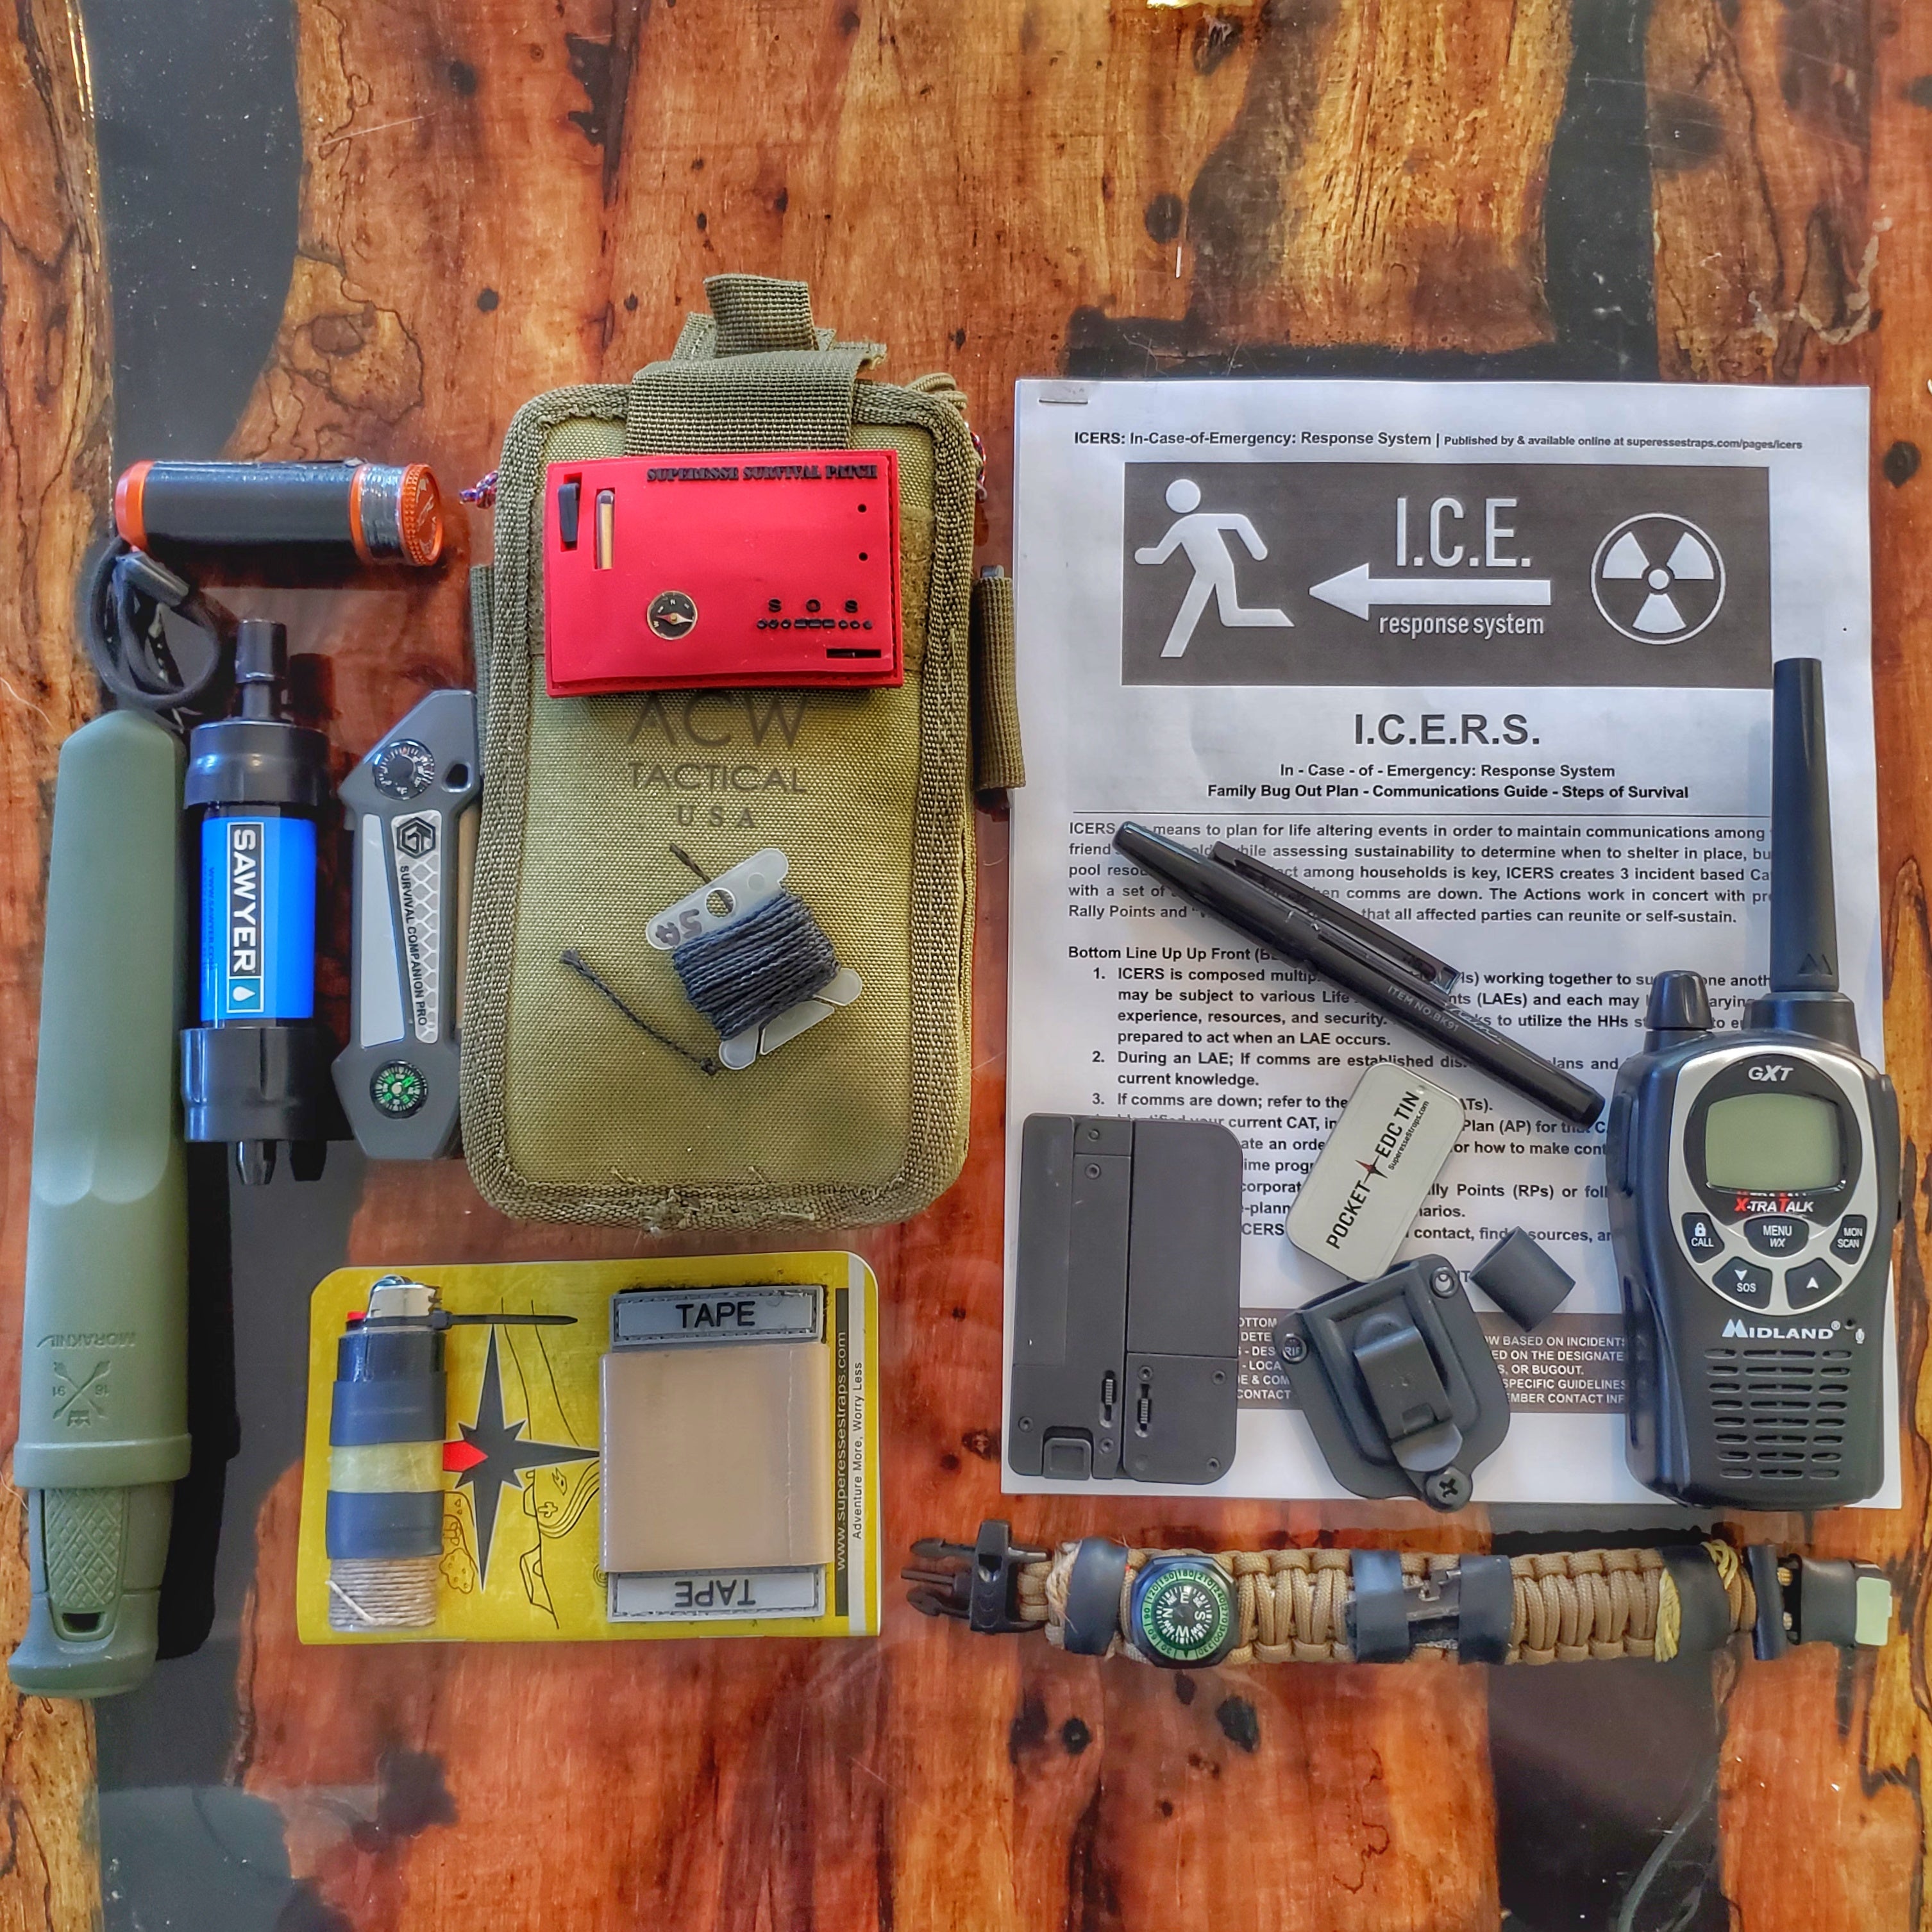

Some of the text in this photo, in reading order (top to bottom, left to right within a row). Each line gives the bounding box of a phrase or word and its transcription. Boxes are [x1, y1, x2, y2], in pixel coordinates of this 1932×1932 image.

[1075, 432, 1802, 451] ICERS: In-Case-of-Emergency: Response System Published by & available online at superessestraps.com/pages/icers
[647, 465, 877, 482] SUPERESSE SURVIVAL PATCH
[1397, 498, 1531, 567] I.C.E.
[1380, 614, 1543, 639] response system
[626, 692, 808, 749] ACW
[1356, 714, 1539, 744] I.C.E.R.S.
[628, 762, 807, 793] TACTICAL
[1281, 764, 1615, 780] In Case of Emergency: Response System
[1208, 784, 1688, 801] Family Bug Out Plan Communications Guide Steps of Survival
[1070, 821, 1115, 835] ICERS
[1207, 825, 1220, 836] to
[1227, 823, 1257, 839] plan
[1263, 823, 1284, 836] for
[1289, 824, 1311, 836] life
[1317, 824, 1372, 839] altering
[1379, 825, 1427, 837] events
[1434, 825, 1447, 837] in
[1453, 825, 1493, 837] order
[1498, 825, 1513, 837] to
[1518, 825, 1581, 837] maintain
[1586, 825, 1709, 838] communications
[1715, 829, 1764, 841] among
[1273, 844, 1746, 862] assessing sustainability to determine when to shelter in place,
[1304, 866, 1743, 882] among households is key, ICERS creates 3 incident based
[233, 829, 256, 973] SAWYER
[1070, 905, 1105, 920] Rally
[1110, 905, 1155, 917] Points
[1161, 907, 1188, 918] and
[1395, 908, 1411, 920] all
[1416, 908, 1475, 921] affected
[1481, 909, 1532, 924] parties
[1537, 912, 1563, 921] can
[1569, 909, 1620, 921] reunite
[1626, 912, 1642, 921] or
[1646, 910, 1736, 923] self-sustain.
[401, 866, 427, 1026] SURVIVAL COMPANION PRO
[1069, 946, 1250, 962] Bottom Line Up Up Front
[1388, 986, 1413, 1005] ITEM
[1118, 1009, 1388, 1028] experience, resources, and security.
[1118, 1030, 1390, 1045] prepared to act when an LAE occurs.
[1118, 1072, 1258, 1088] current knowledge.
[1749, 1065, 1793, 1081] GXT
[1325, 1091, 1420, 1249] POCKET EDC TIN
[1457, 1184, 1577, 1200] Points (RPs) or
[1415, 1227, 1474, 1241] contact,
[1763, 1225, 1792, 1236] MENU
[1844, 1228, 1863, 1236] MON
[1691, 1238, 1713, 1247] CALL
[1770, 1238, 1786, 1247] WX
[1837, 1239, 1860, 1248] SCAN
[1736, 1282, 1756, 1293] SOS
[676, 1301, 755, 1327] TAPE
[1503, 1336, 1563, 1347] BASED ON
[1511, 1350, 1554, 1361] ON THE
[1511, 1365, 1584, 1375] OR BUGOUT.
[1548, 1393, 1603, 1404] CONTACT
[837, 1332, 848, 1570] www.superessestraps.com
[853, 1363, 864, 1539] Adventure More, Worry Less
[675, 1580, 755, 1607] TAPE
